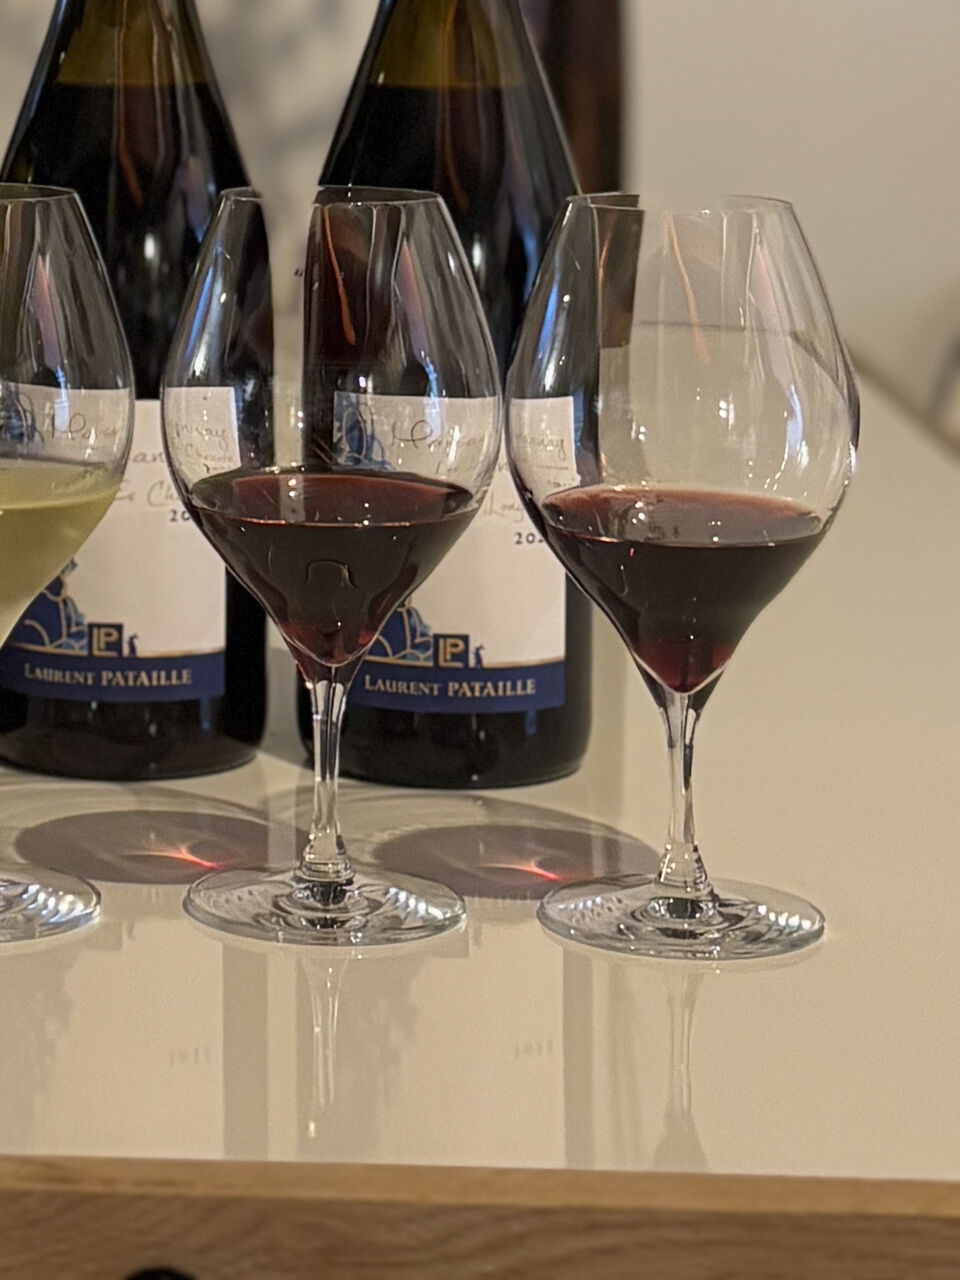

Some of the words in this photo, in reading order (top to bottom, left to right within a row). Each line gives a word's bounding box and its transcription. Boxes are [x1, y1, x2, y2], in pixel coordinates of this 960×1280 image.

[24, 662, 94, 686] LAURENT
[100, 668, 192, 687] PATAILLE
[364, 674, 442, 697] LAURENT
[447, 677, 536, 699] PATAILLE
